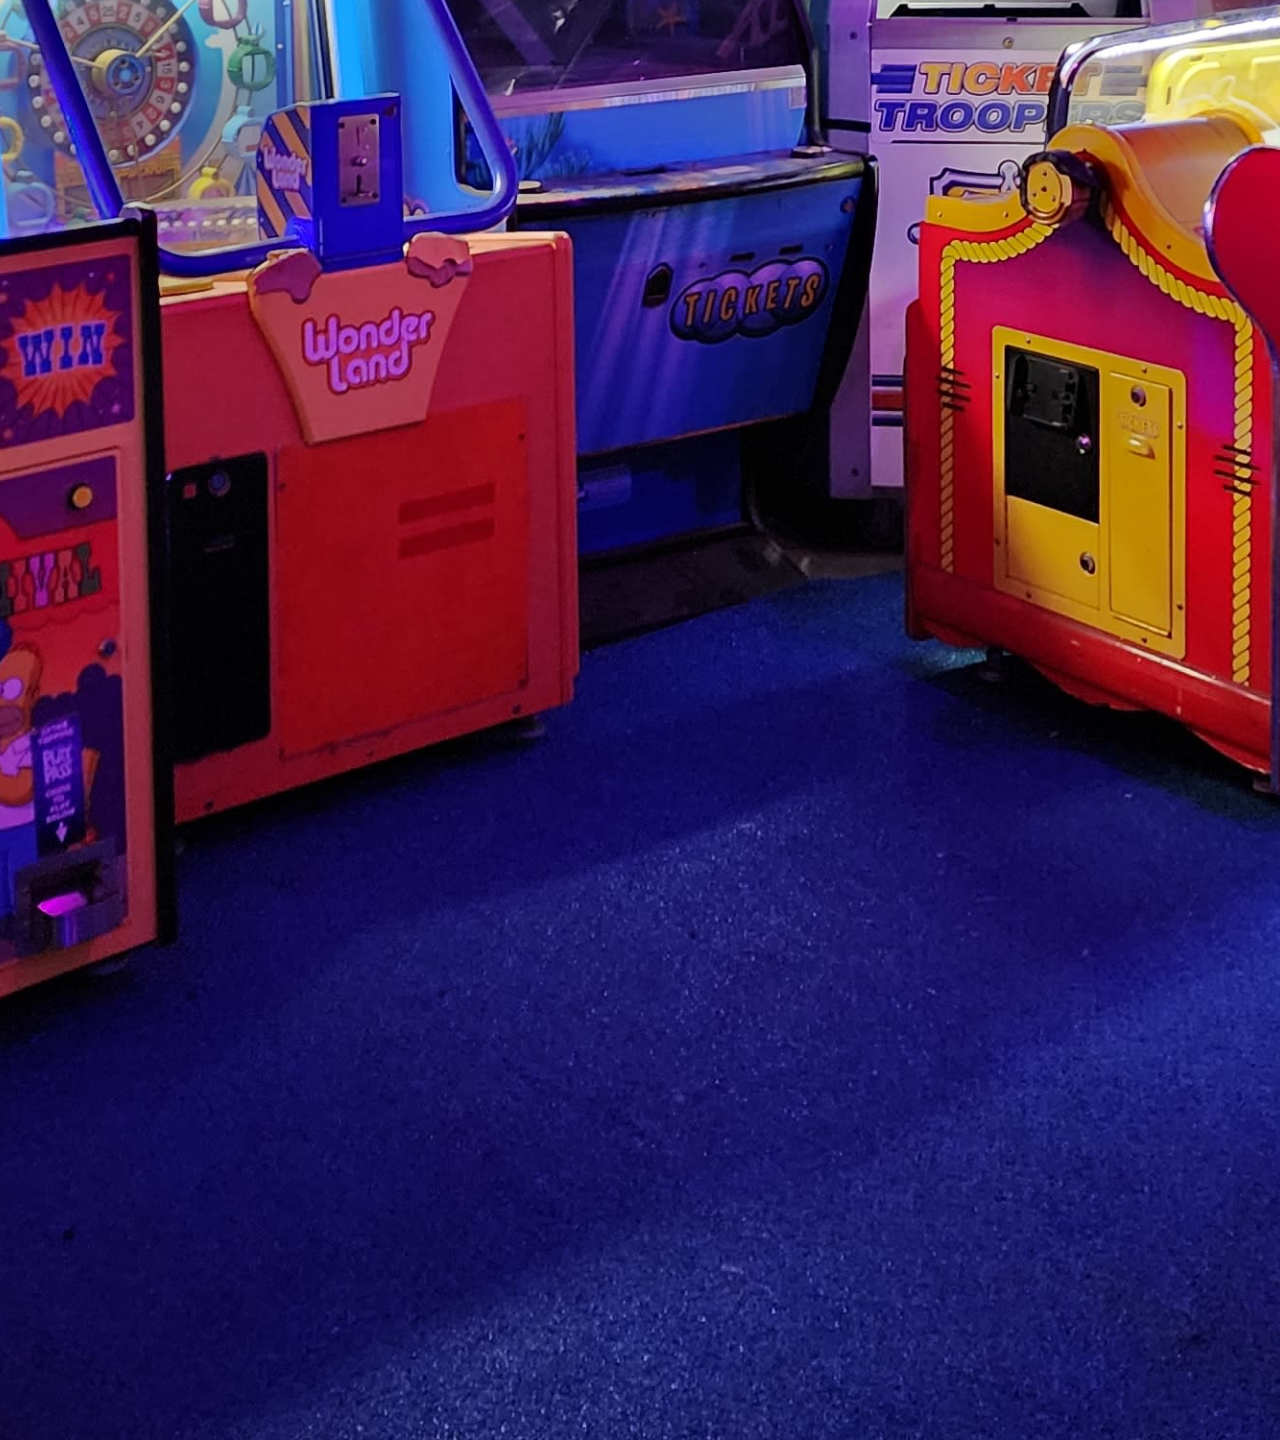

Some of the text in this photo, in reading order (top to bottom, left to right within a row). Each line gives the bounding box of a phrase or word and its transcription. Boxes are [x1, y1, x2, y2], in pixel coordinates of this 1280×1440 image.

[684, 272, 822, 328] TICKETS
[17, 320, 108, 379] WIN
[303, 308, 434, 363] Wonder
[329, 337, 410, 393] Land
